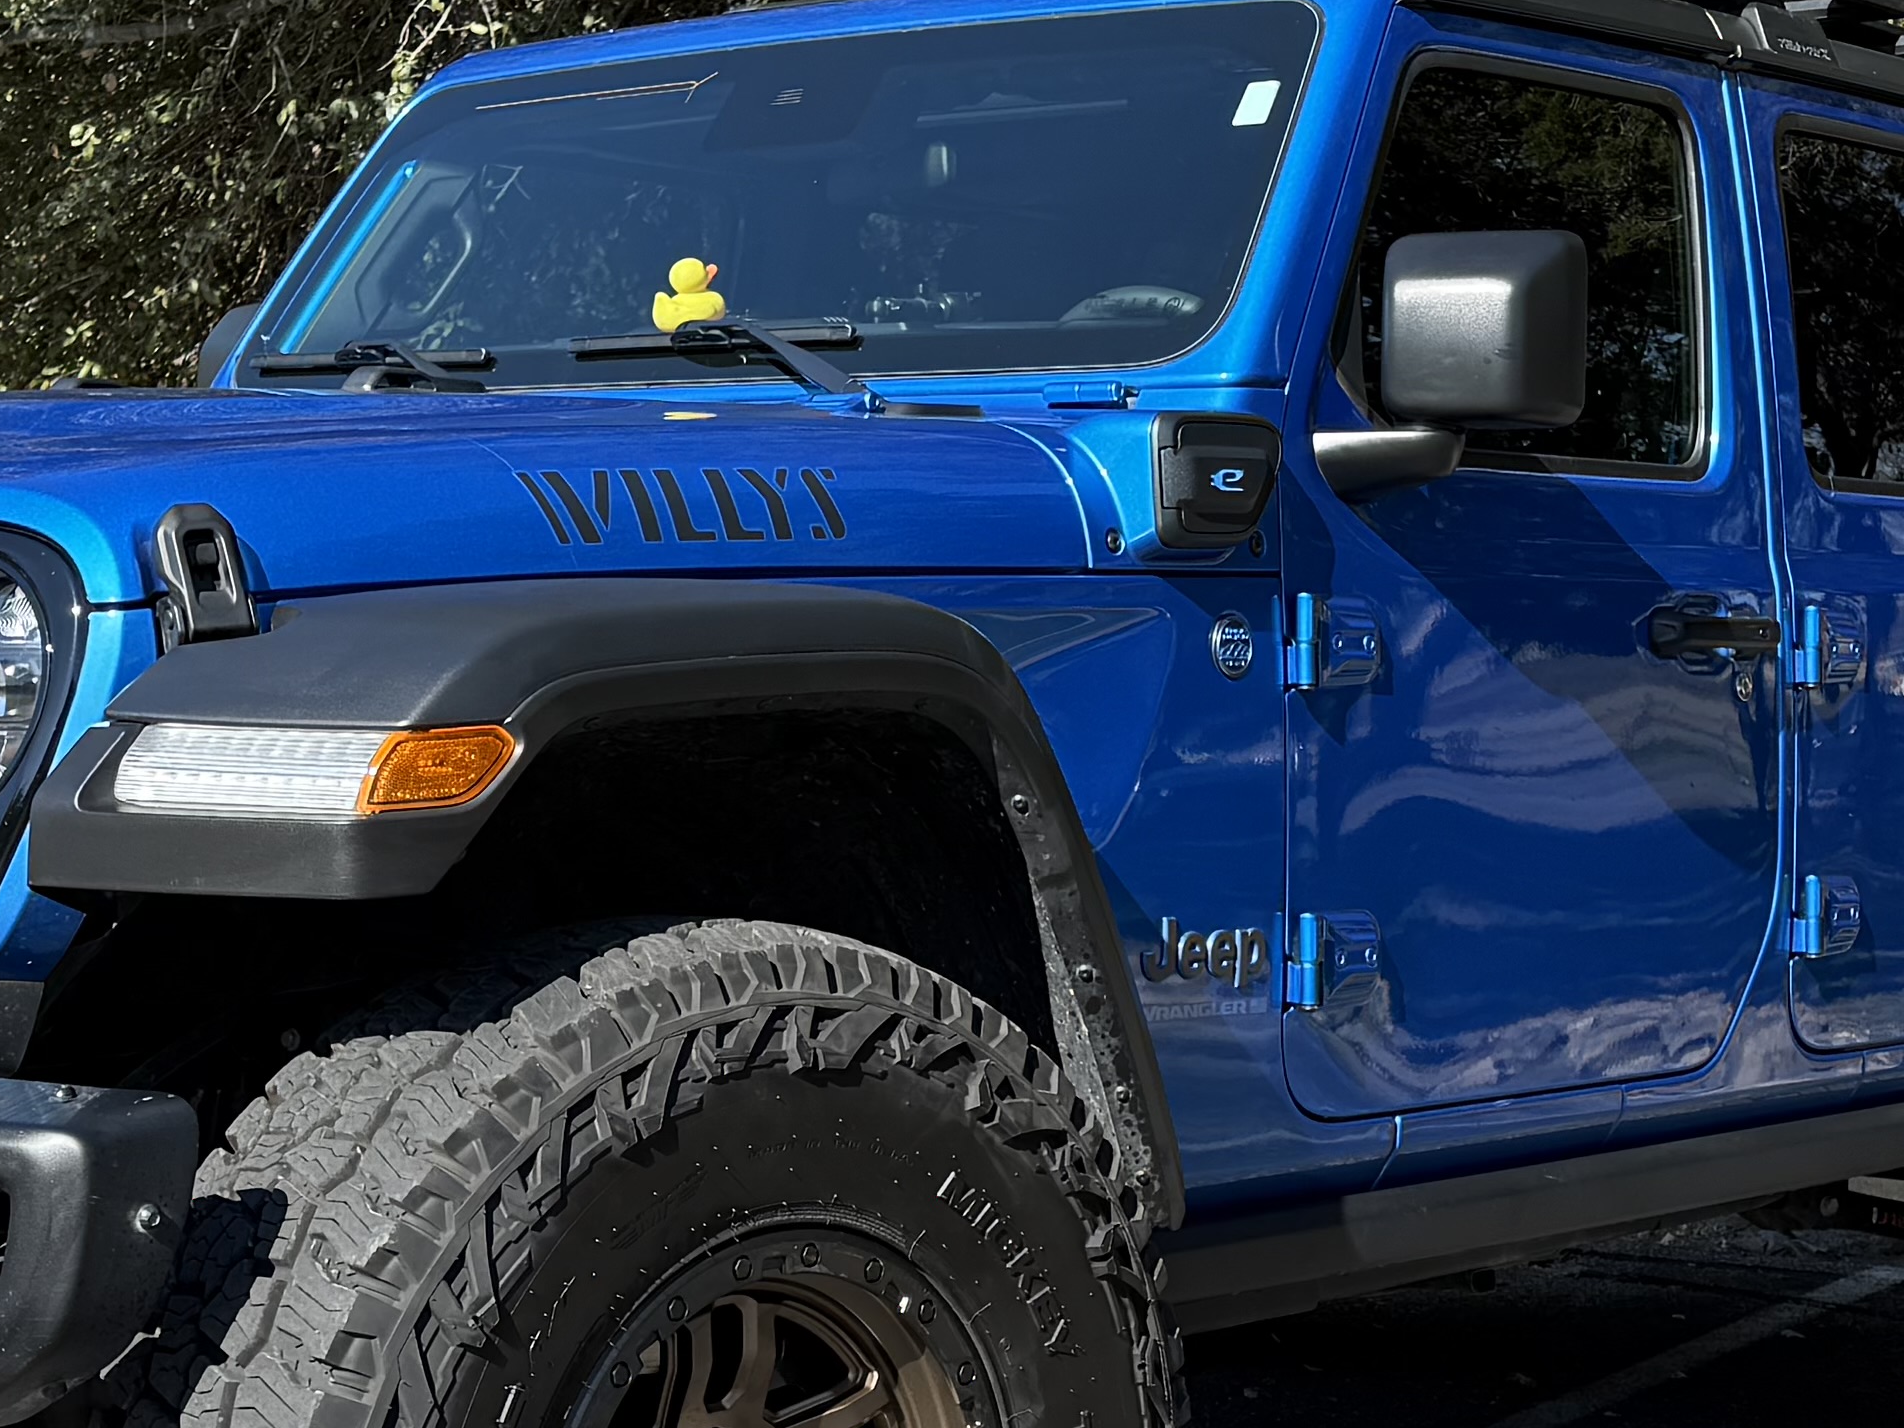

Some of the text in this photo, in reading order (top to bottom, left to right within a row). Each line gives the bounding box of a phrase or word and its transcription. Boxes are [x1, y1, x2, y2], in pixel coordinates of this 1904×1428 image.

[514, 467, 847, 545] WILLYS
[1140, 916, 1266, 989] Jeep
[936, 1171, 1085, 1357] MICKEY
